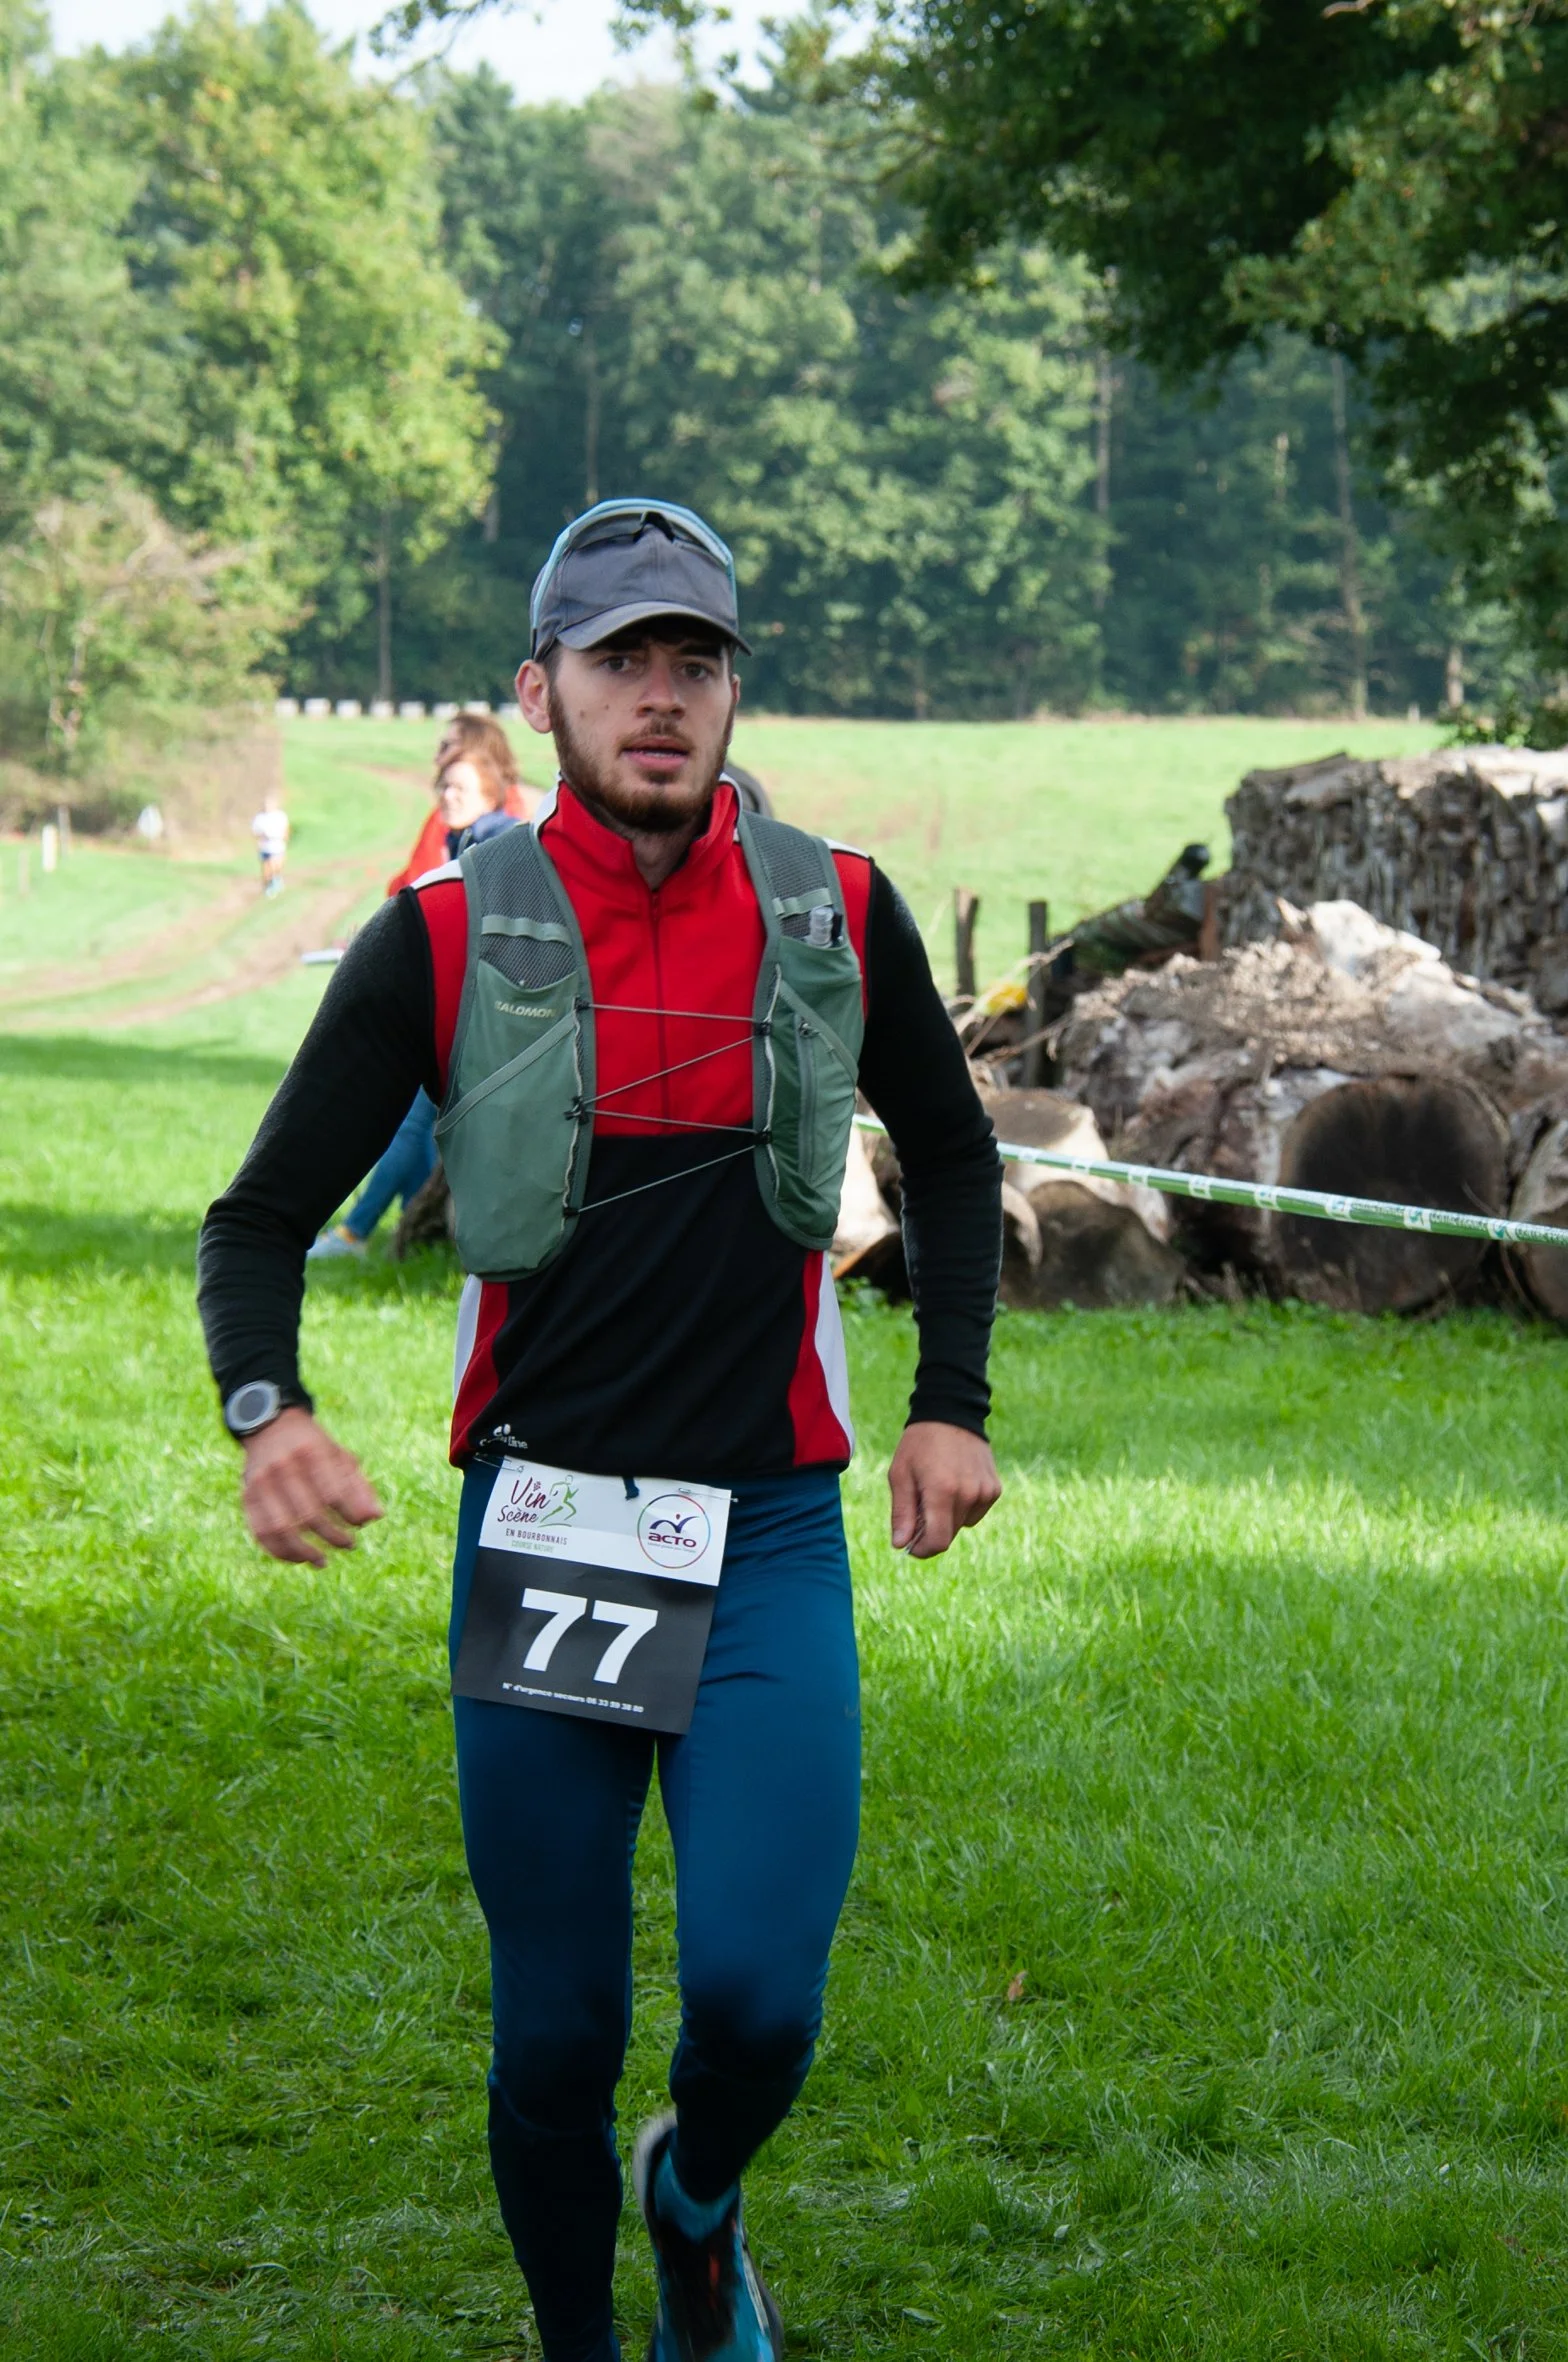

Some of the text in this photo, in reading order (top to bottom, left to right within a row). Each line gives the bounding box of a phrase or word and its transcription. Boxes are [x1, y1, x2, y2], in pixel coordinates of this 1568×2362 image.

[497, 1505, 538, 1523] Scène
[506, 1528, 568, 1545] EN BOURBONNAIS
[521, 1587, 658, 1684] 77
